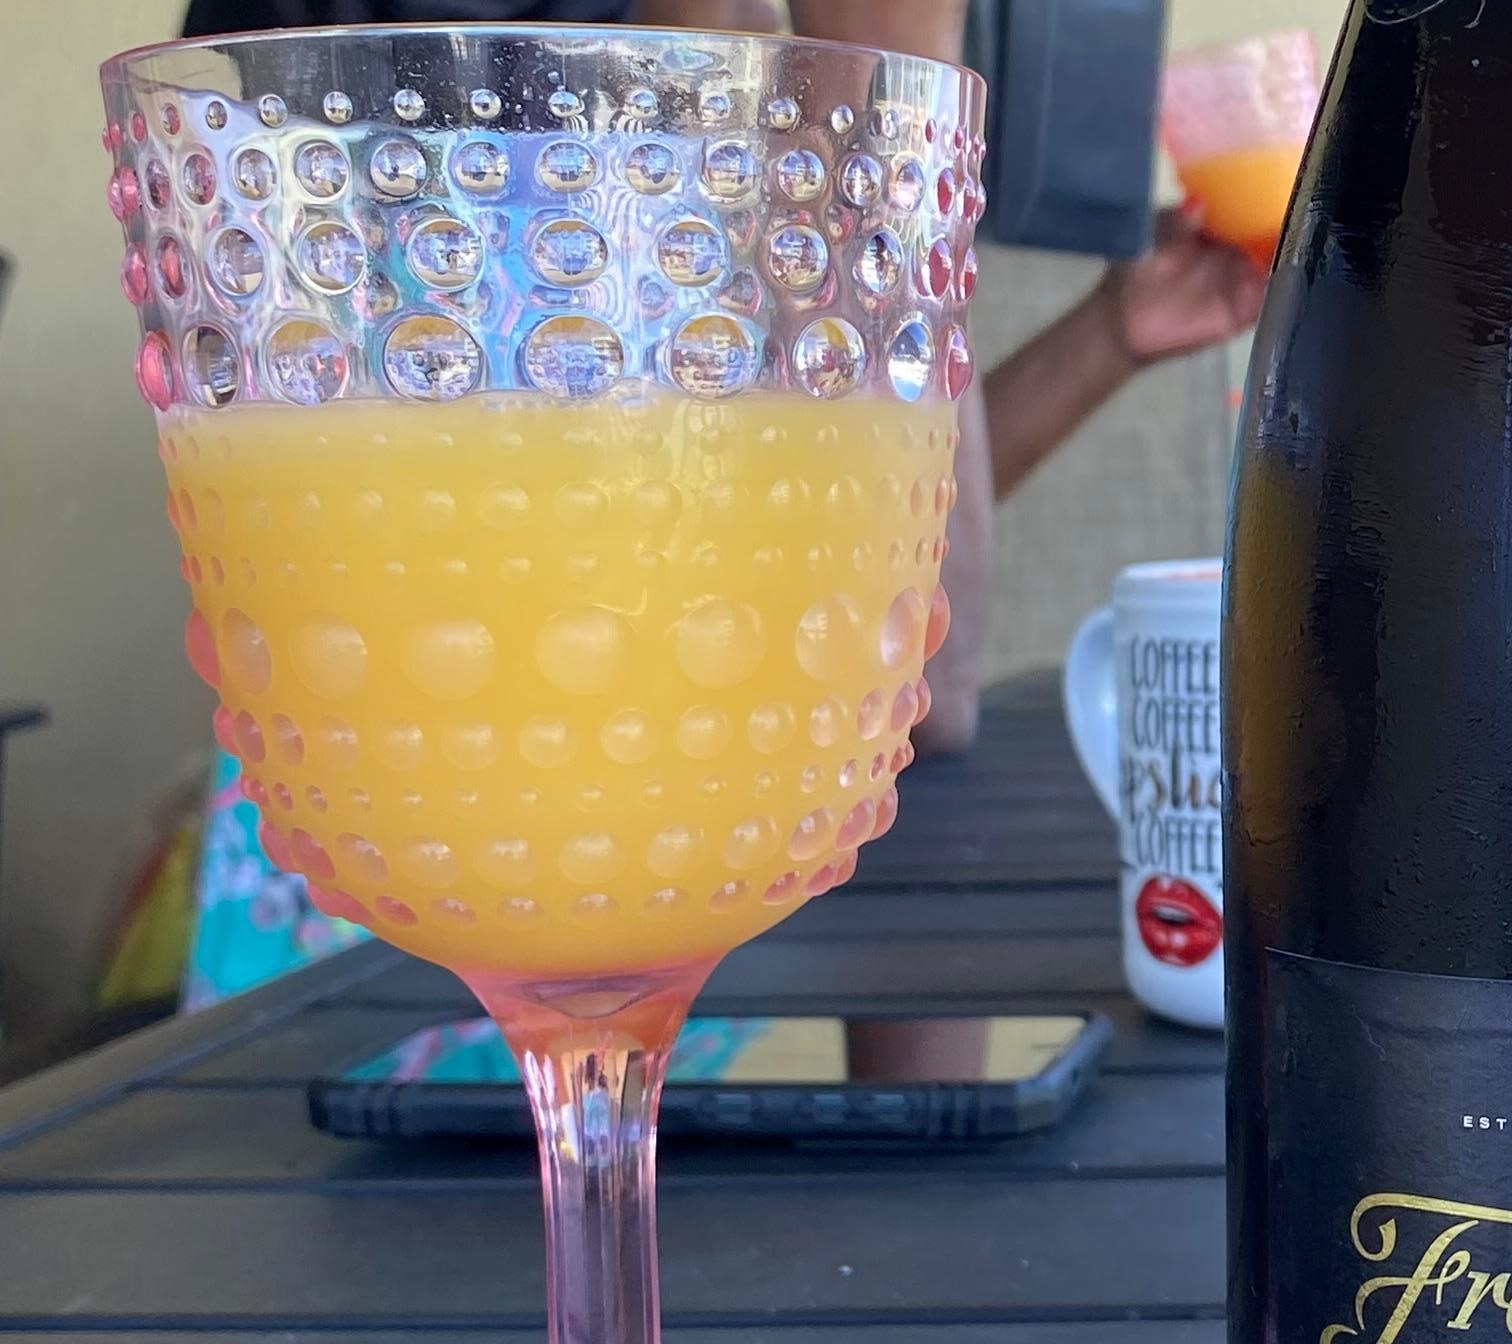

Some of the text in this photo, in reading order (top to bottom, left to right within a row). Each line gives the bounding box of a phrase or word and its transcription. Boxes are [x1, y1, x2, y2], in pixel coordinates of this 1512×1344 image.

[1131, 636, 1219, 694] COFFEE
[1132, 696, 1219, 753] COFFEE
[1136, 813, 1221, 874] COFFEE
